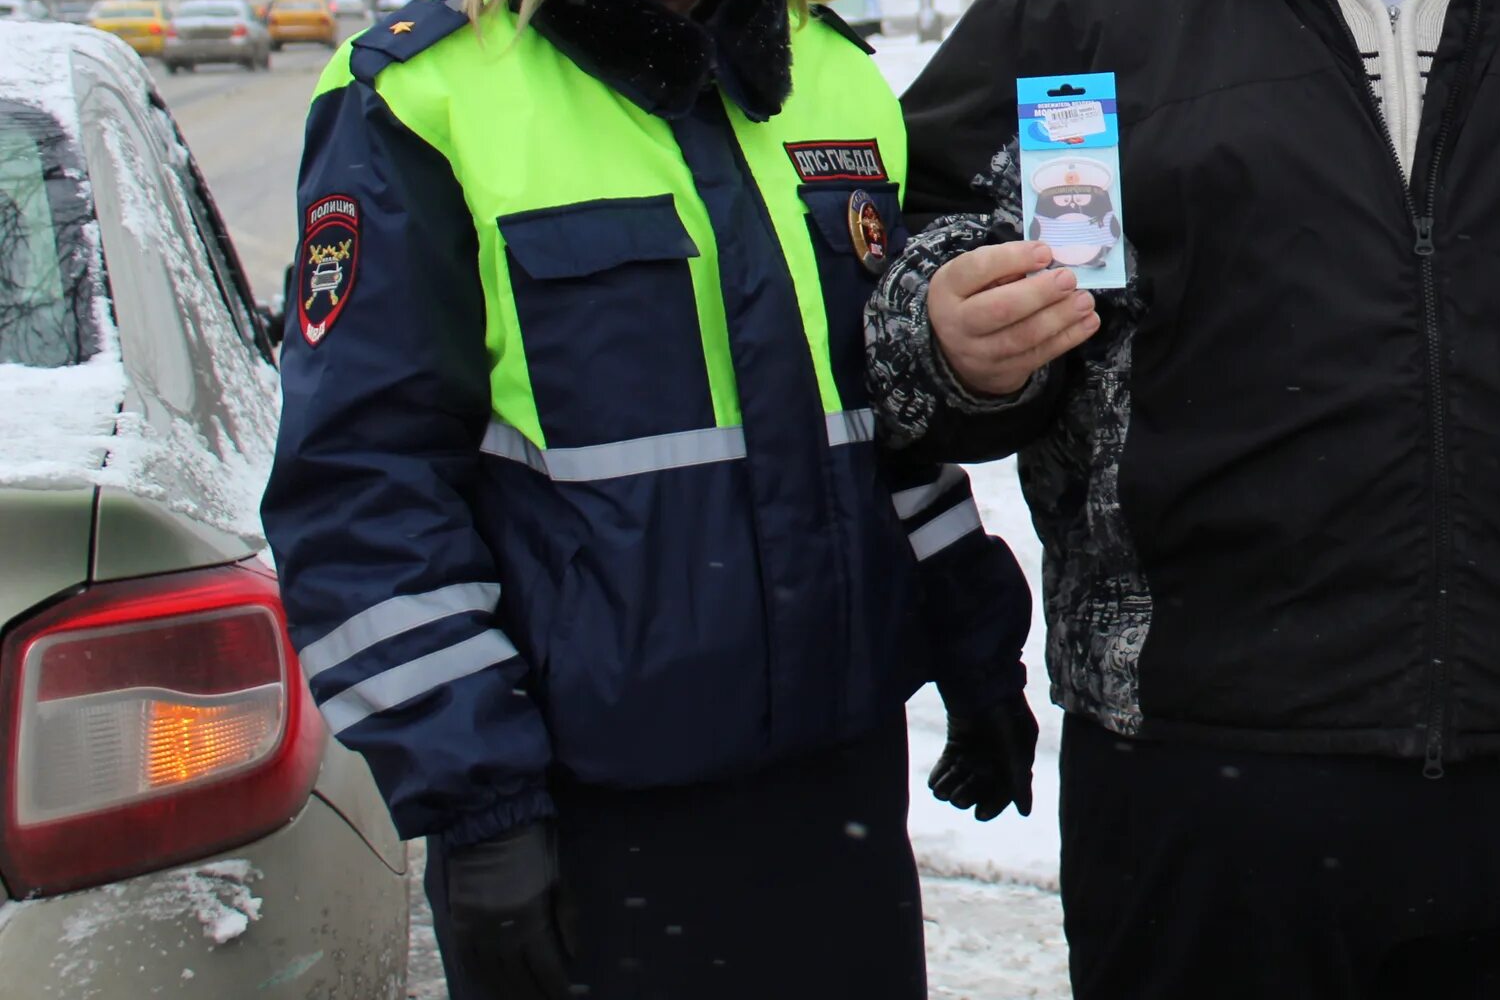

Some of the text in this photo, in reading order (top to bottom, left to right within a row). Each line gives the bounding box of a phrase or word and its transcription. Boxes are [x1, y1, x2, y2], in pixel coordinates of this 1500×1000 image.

[794, 149, 881, 176] ДПС ГИБДД
[310, 200, 355, 224] ПОЛИЦИЯ
